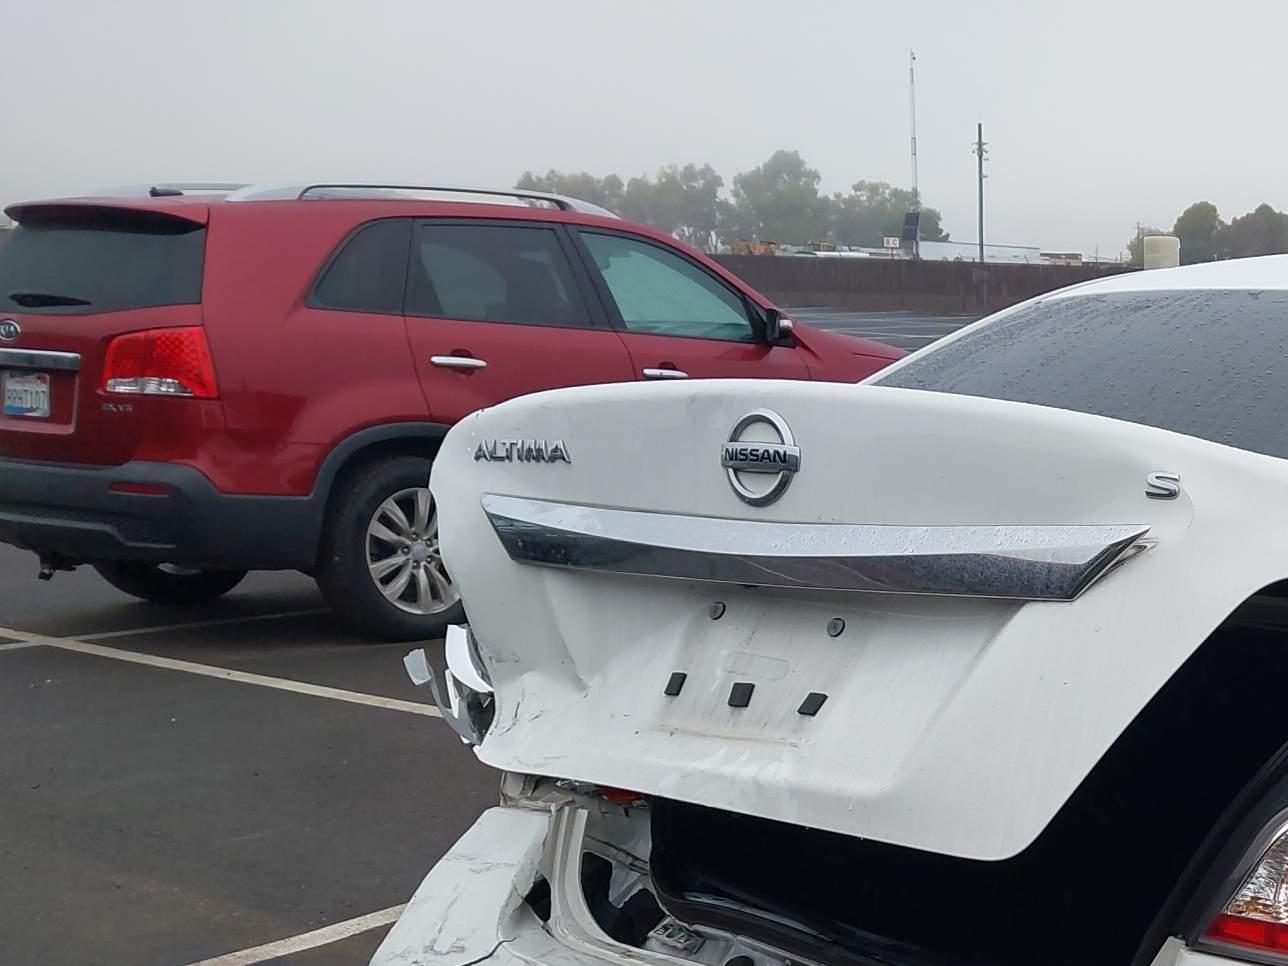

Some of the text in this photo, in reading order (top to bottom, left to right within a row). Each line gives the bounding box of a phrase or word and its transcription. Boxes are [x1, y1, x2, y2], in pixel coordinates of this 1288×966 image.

[473, 438, 572, 464] ALTIMA
[725, 447, 787, 464] NISSAN
[1145, 471, 1180, 500] S
